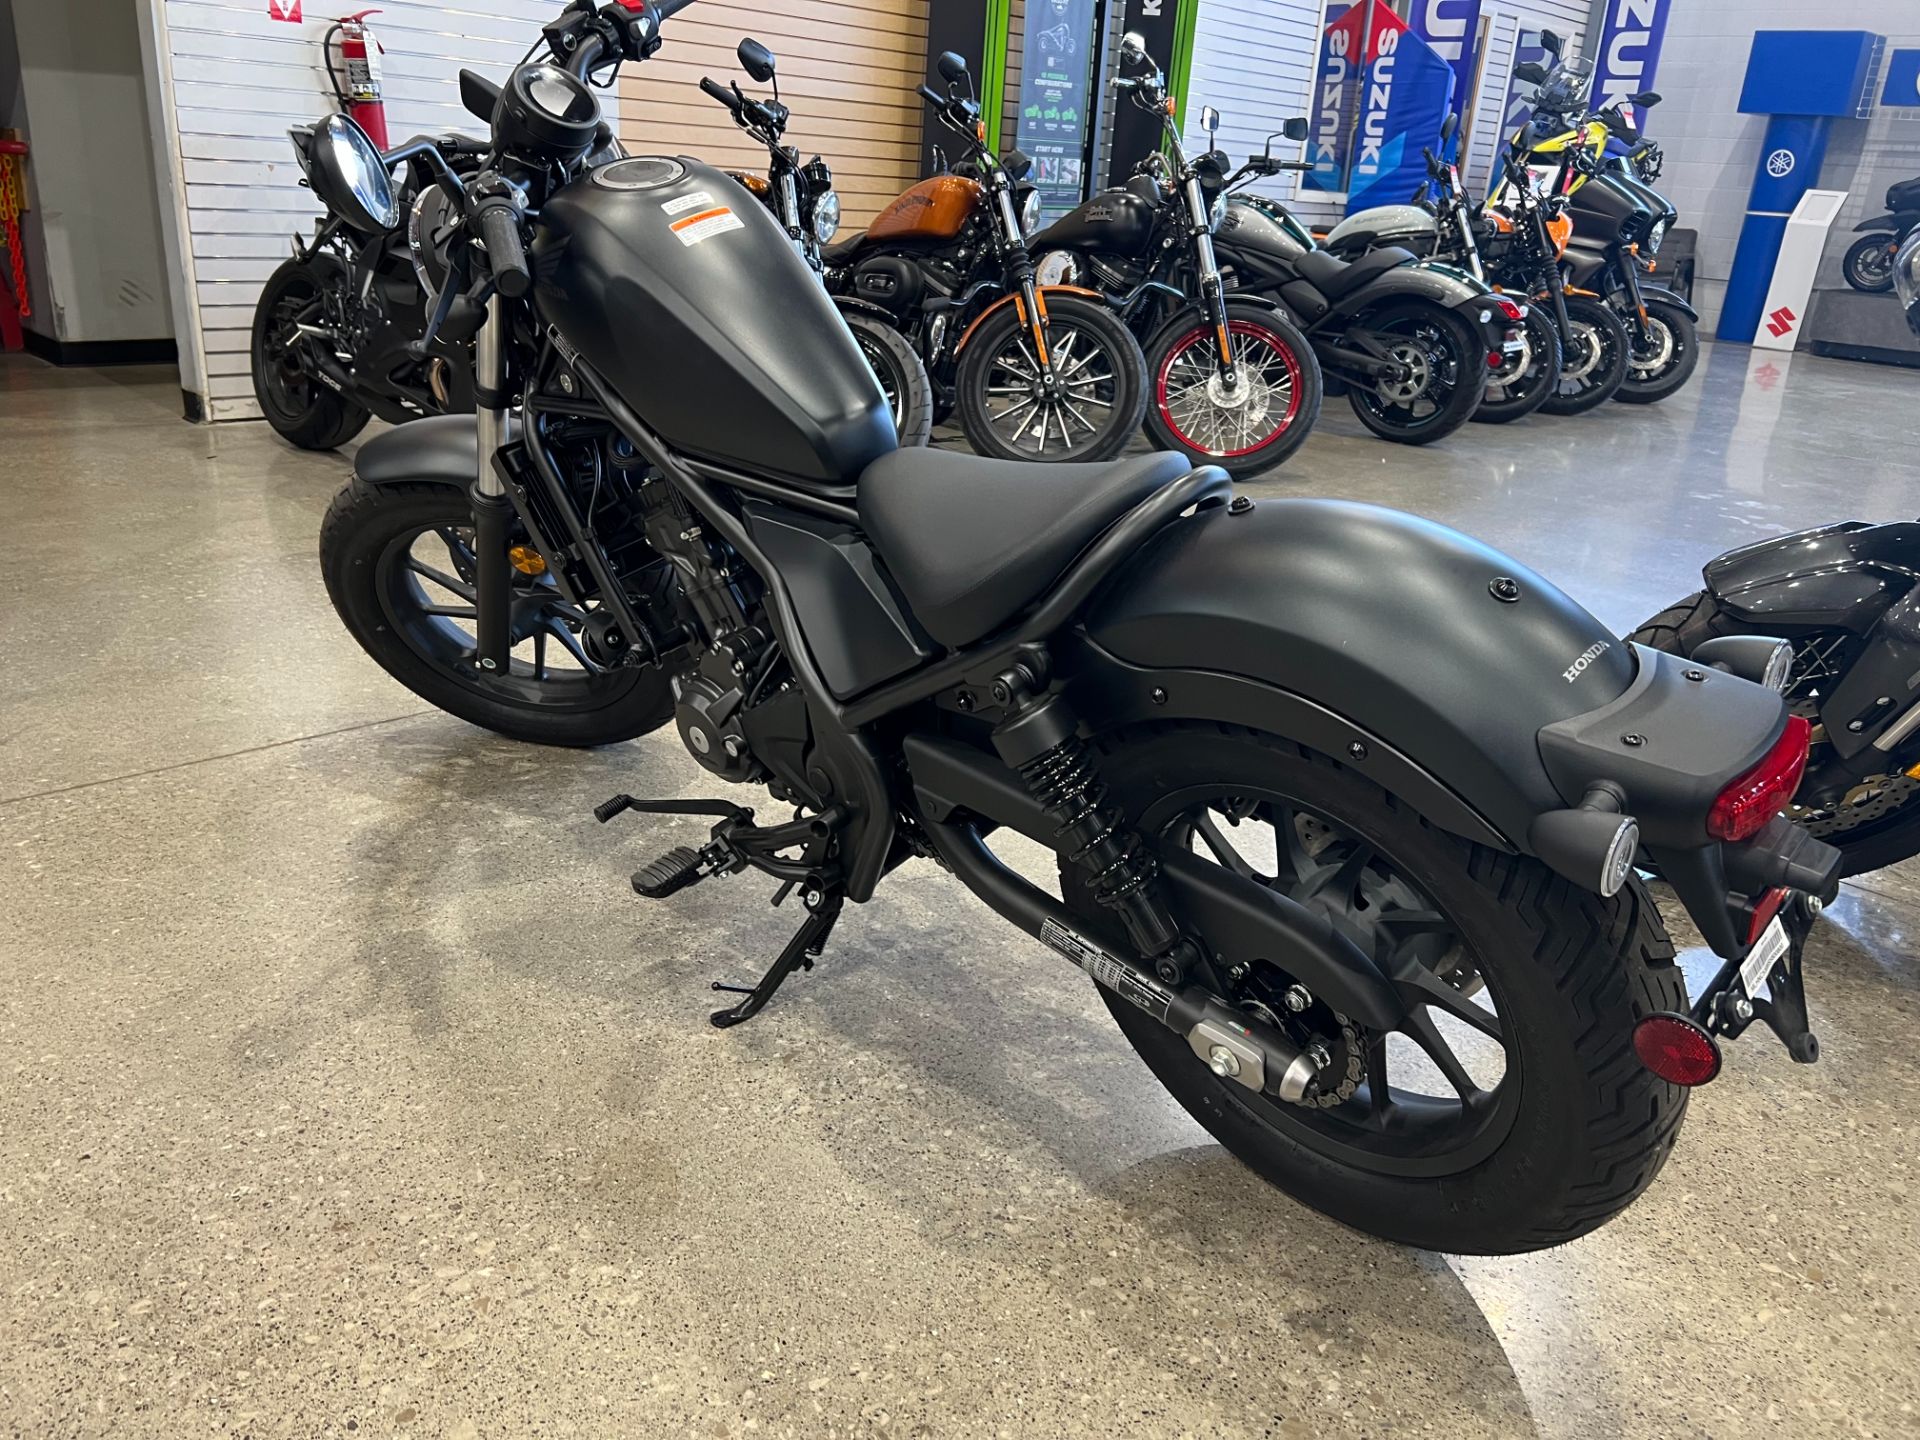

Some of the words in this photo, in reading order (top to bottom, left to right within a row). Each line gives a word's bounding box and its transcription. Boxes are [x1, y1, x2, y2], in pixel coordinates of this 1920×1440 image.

[1359, 27, 1399, 175] SUZUKI
[317, 370, 342, 392] TOCE
[1562, 640, 1610, 683] HONDA
